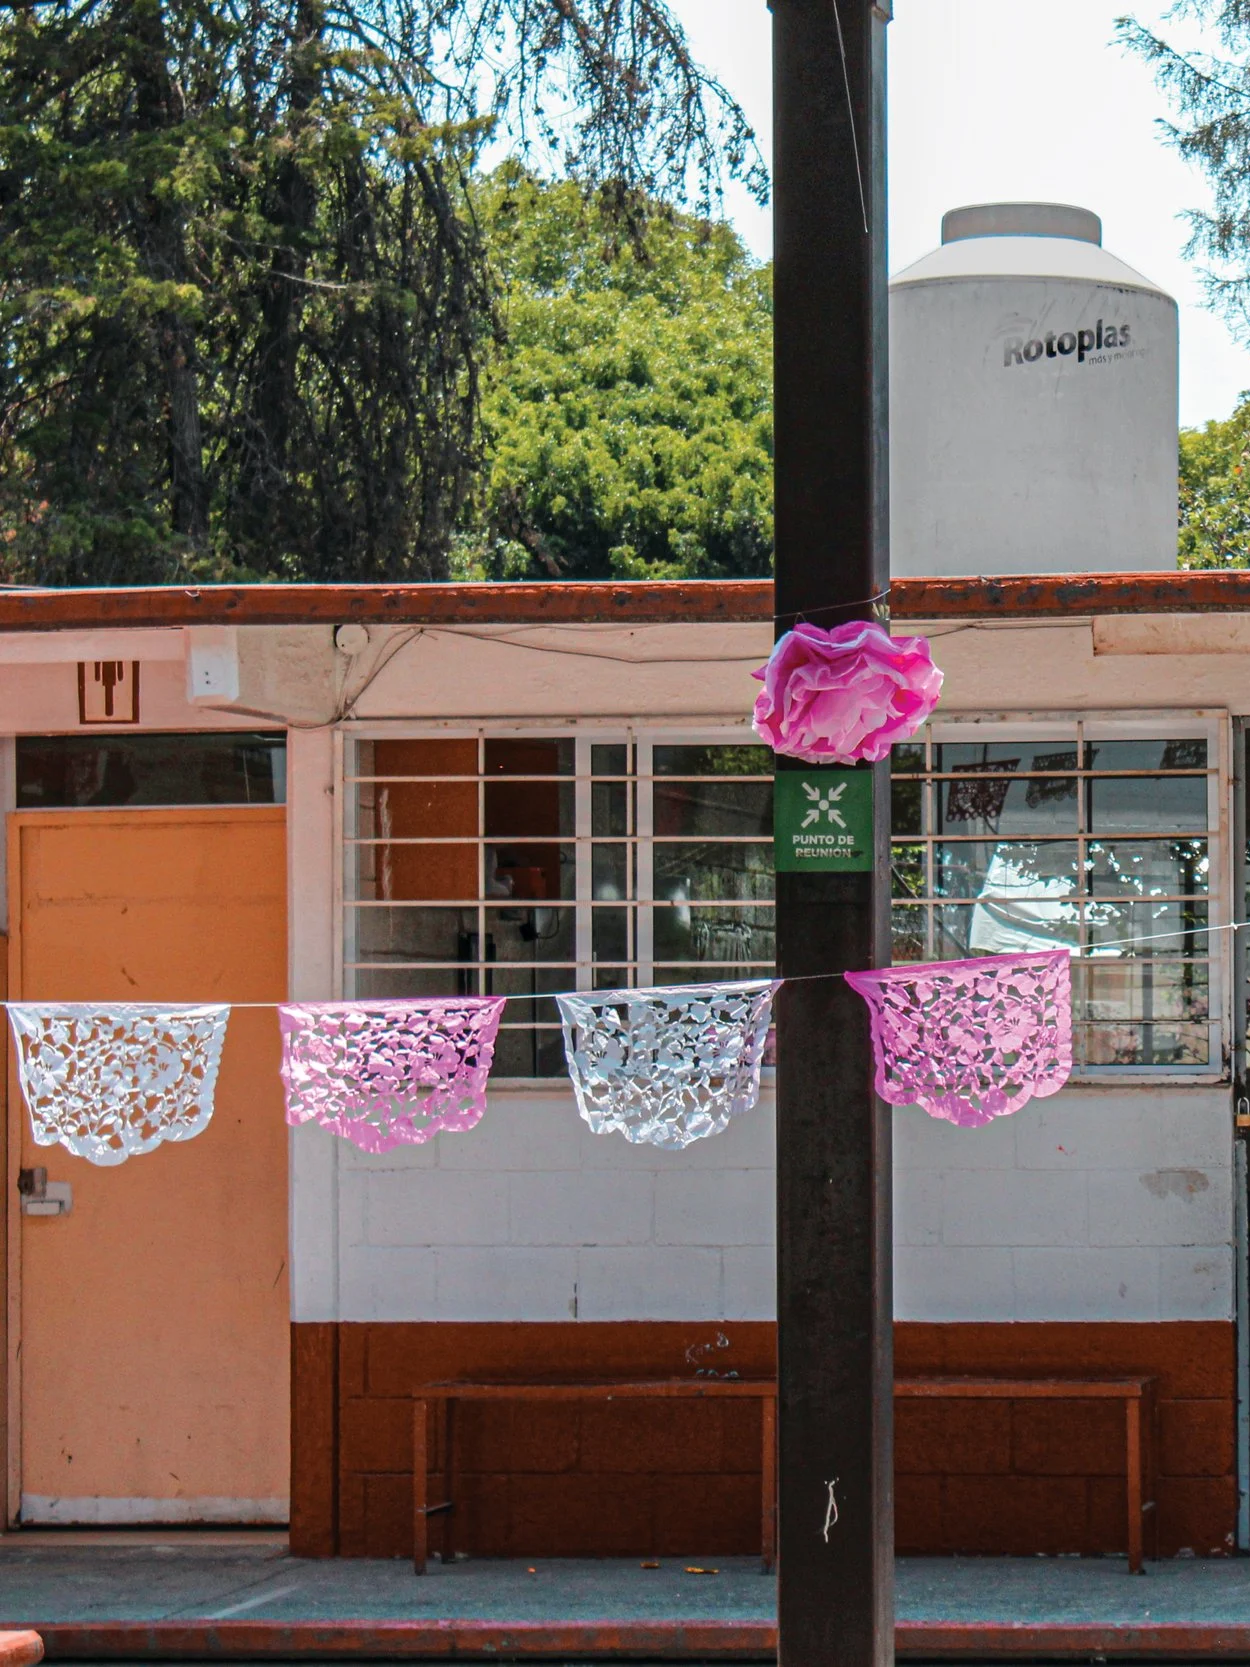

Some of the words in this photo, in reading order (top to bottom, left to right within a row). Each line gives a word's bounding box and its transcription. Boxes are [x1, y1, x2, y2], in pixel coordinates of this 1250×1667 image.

[1003, 319, 1131, 367] Rotoplas
[792, 835, 835, 845] PUNTO
[838, 835, 855, 845] DE
[795, 846, 851, 858] REUNIÓN
